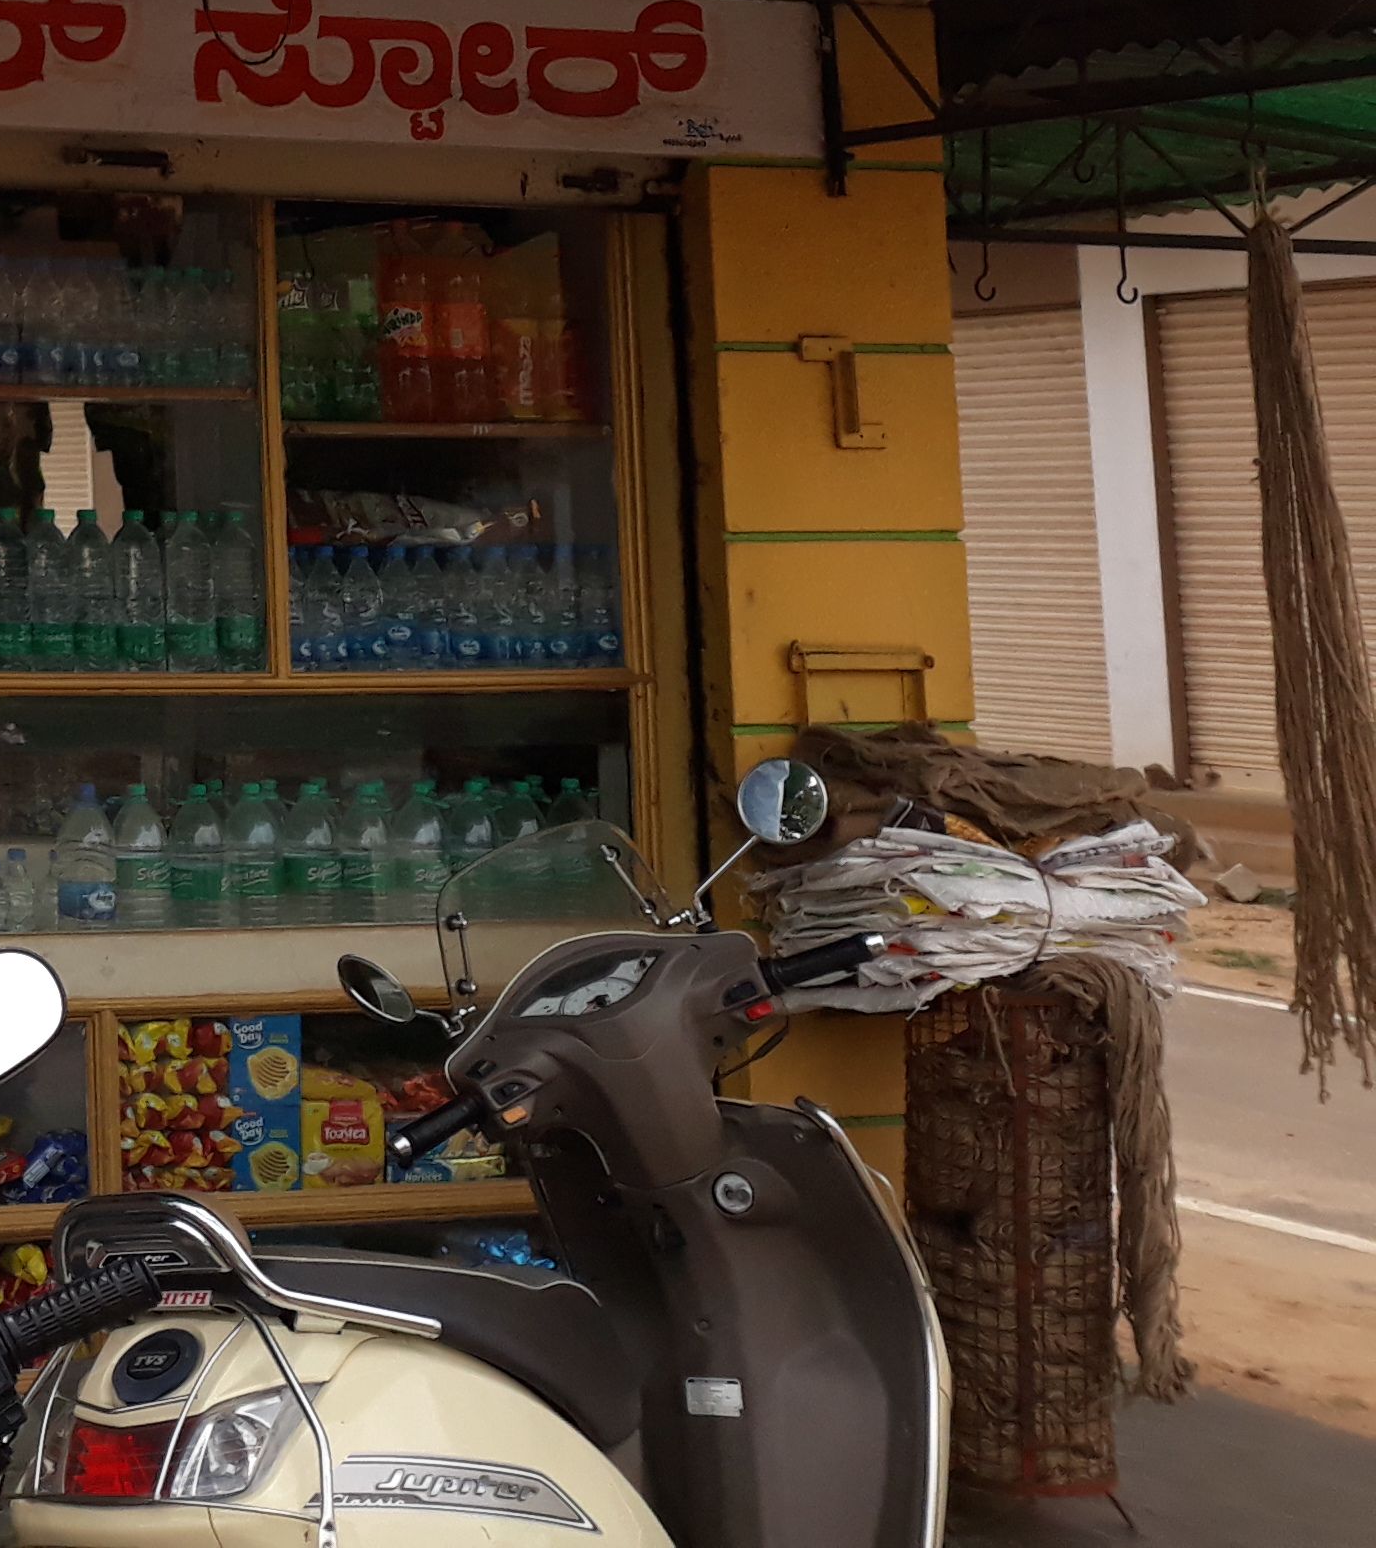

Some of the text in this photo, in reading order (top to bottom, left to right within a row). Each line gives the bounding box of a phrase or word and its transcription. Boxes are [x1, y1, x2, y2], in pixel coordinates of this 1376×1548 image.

[233, 1020, 264, 1035] Good
[239, 1031, 262, 1045] Day
[234, 1115, 265, 1131] Good
[240, 1126, 264, 1141] Day
[134, 1354, 168, 1366] TVS
[375, 1468, 540, 1502] Jupiter
[333, 1493, 405, 1506] Classic
